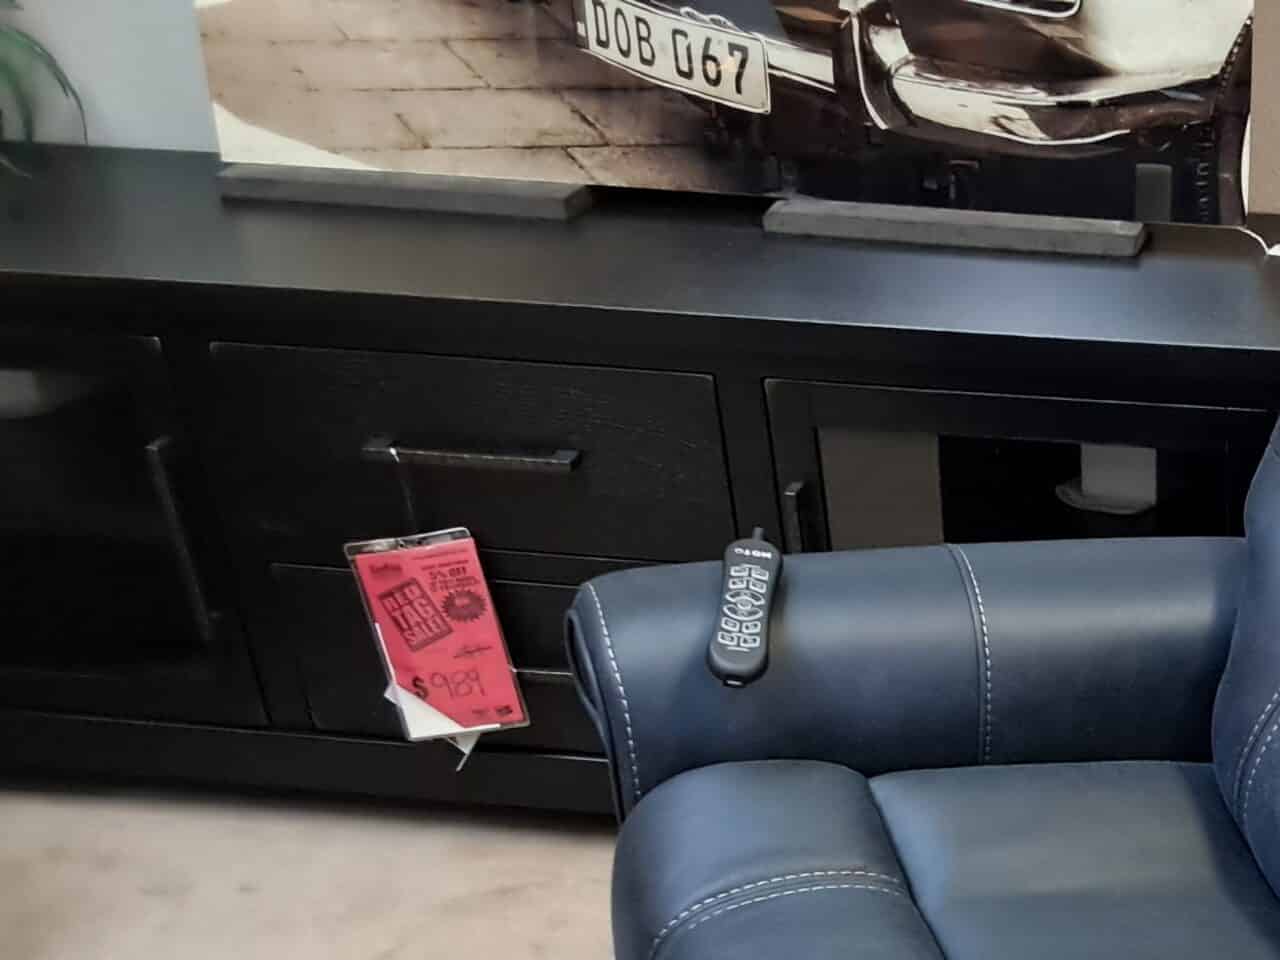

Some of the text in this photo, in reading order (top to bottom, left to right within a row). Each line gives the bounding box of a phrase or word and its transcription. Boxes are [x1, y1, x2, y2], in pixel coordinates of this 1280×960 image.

[592, 1, 749, 96] DOB 067
[390, 596, 435, 630] TAG
